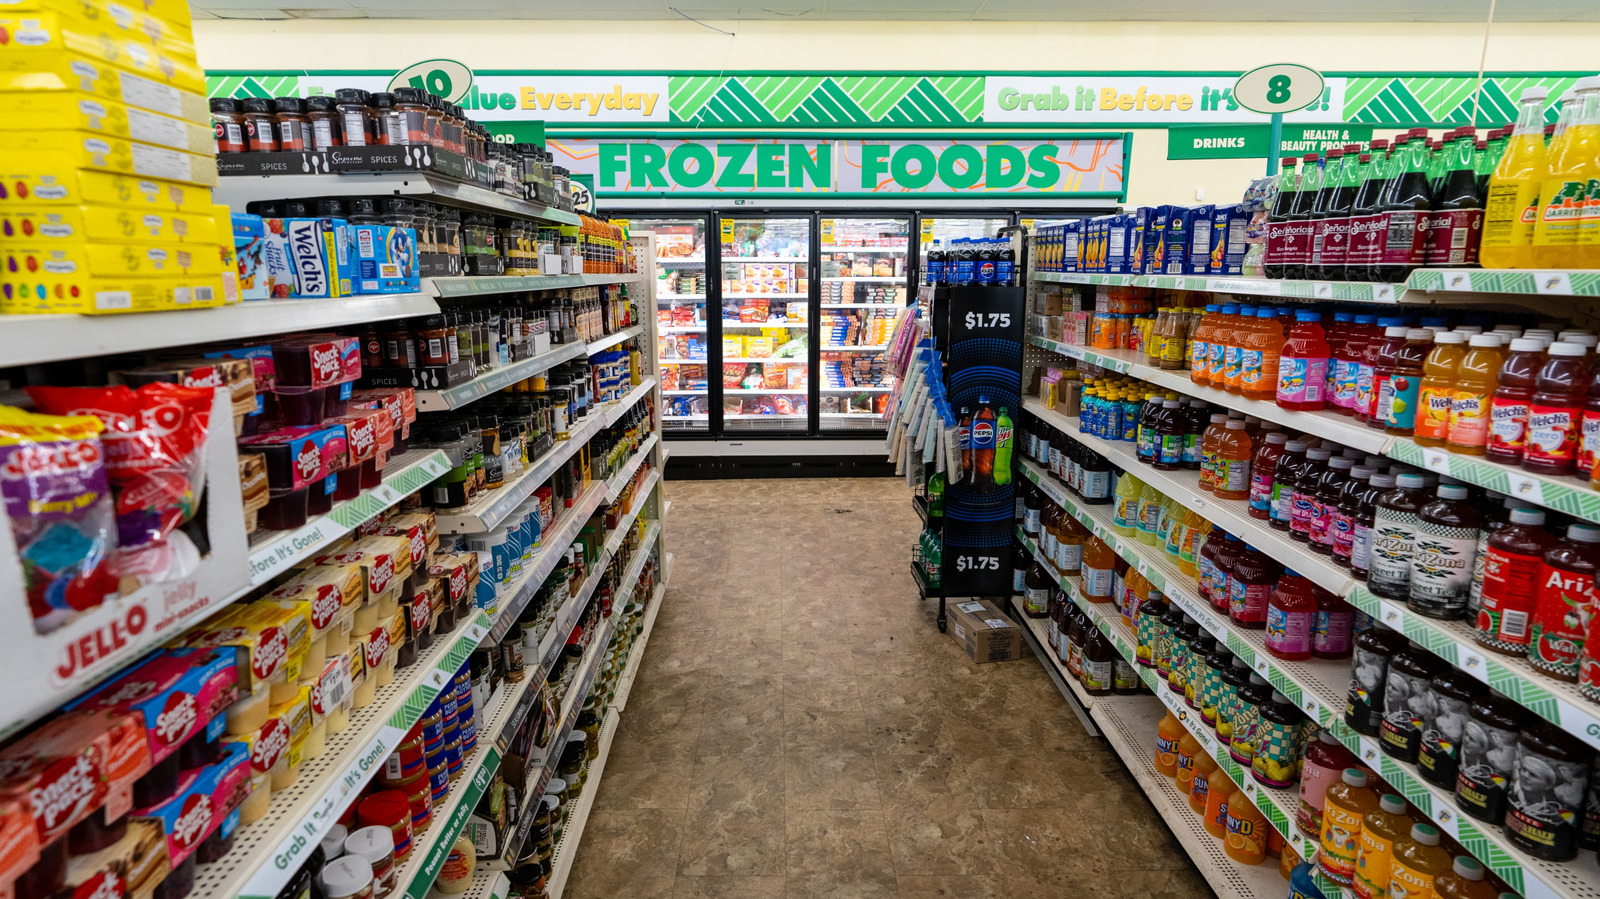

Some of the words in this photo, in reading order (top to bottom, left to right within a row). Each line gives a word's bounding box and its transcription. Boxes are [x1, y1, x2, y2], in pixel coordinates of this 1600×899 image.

[408, 69, 453, 101] 10
[1266, 74, 1292, 105] 8
[520, 84, 660, 116] Everyday
[998, 86, 1069, 112] Grab
[1075, 86, 1096, 112] it
[1099, 86, 1194, 112] Before
[1193, 136, 1246, 150] DRINKS
[1281, 140, 1318, 152] BEAUTY
[1303, 129, 1339, 141] HEALTH
[1341, 129, 1350, 141] &
[261, 161, 288, 172] SPICES
[370, 155, 398, 165] SPICES
[598, 142, 831, 189] FROZEN
[861, 144, 1061, 189] FOODS
[1323, 222, 1350, 238] Señor
[265, 241, 278, 276] Snacks
[272, 247, 286, 272] Fruit
[294, 223, 320, 293] Welch's
[965, 311, 1011, 330] $1.75
[314, 349, 339, 368] Snack
[320, 360, 340, 379] pack
[371, 377, 398, 386] SPICES
[384, 397, 401, 412] Snack
[1493, 406, 1527, 418] Welch's
[1495, 422, 1518, 432] zero
[1531, 412, 1569, 427] Welch's
[351, 421, 374, 443] Snack
[974, 430, 993, 438] PEPSI
[1534, 430, 1559, 440] zero
[297, 446, 321, 468] Snack
[356, 435, 375, 455] pack
[303, 458, 321, 480] pack
[275, 538, 294, 562] It's
[292, 527, 324, 556] Gone!
[409, 529, 425, 551] Snack
[1374, 533, 1416, 554] AriZon
[412, 541, 426, 565] pack
[956, 555, 1000, 573] $1.75
[370, 556, 394, 581] Snack
[450, 569, 467, 590] Snack
[1397, 570, 1410, 579] Te
[376, 569, 395, 593] pack
[454, 580, 468, 602] pack
[1436, 587, 1457, 598] Tea
[312, 586, 341, 619] Snack
[412, 594, 430, 618] Snack
[1170, 589, 1184, 603] Grab
[1184, 600, 1201, 618] Before
[1198, 613, 1208, 626] It's
[1204, 619, 1221, 635] Gone!
[319, 601, 342, 630] pack
[416, 609, 431, 631] pack
[56, 604, 148, 680] JELL-O
[254, 627, 285, 665] Snack
[367, 630, 390, 656] Snack
[261, 646, 287, 677] pack
[375, 644, 391, 668] pack
[157, 692, 197, 736] Snack
[1163, 692, 1175, 705] Grab
[1176, 707, 1191, 724] Beore
[1195, 727, 1212, 747] Gone!
[167, 709, 199, 747] pack
[252, 720, 288, 759] Snack
[259, 739, 289, 771] pack
[30, 754, 94, 818] Snack
[46, 774, 96, 829] pack
[274, 836, 308, 871] Grab
[344, 770, 362, 794] It's
[359, 739, 387, 774] Gone!
[175, 794, 213, 842] Snack
[1514, 809, 1543, 828] LITE
[184, 812, 214, 850] pack
[424, 850, 444, 877] Peanut
[440, 829, 456, 856] Butter
[458, 802, 471, 821] Jelly
